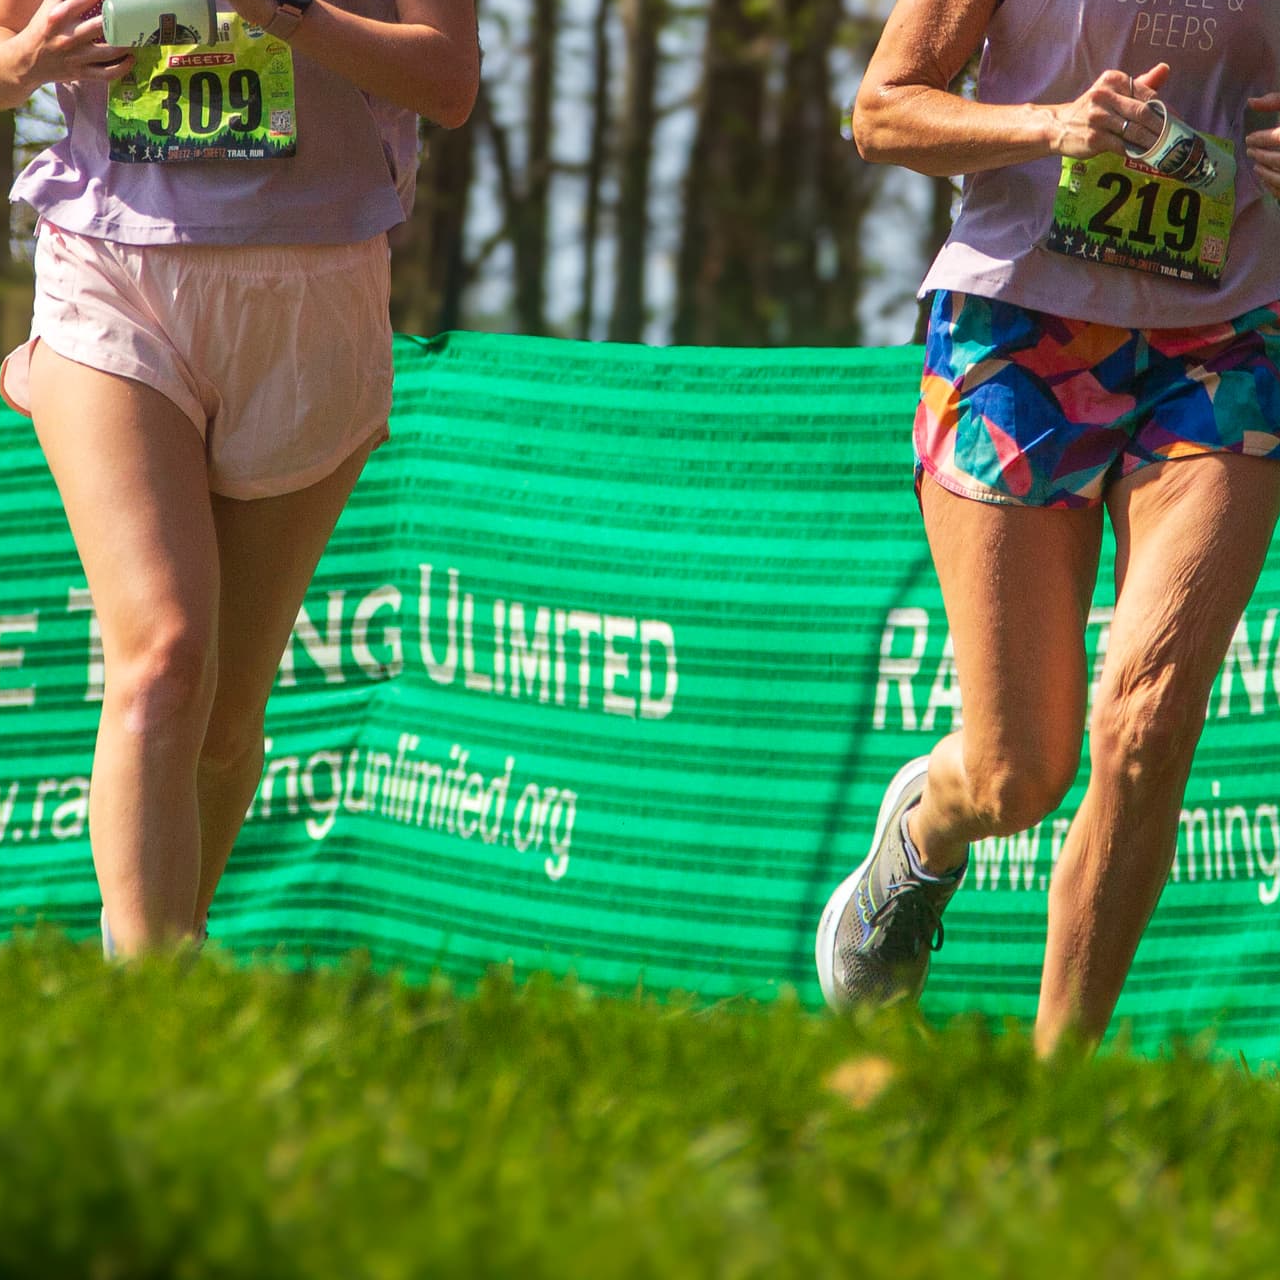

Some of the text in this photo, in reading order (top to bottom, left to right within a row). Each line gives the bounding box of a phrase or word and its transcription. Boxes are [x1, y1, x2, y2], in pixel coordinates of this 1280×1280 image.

[1133, 11, 1218, 52] PEEPS
[171, 54, 231, 66] SHEETZ
[148, 68, 263, 137] 309
[1088, 172, 1202, 253] 219
